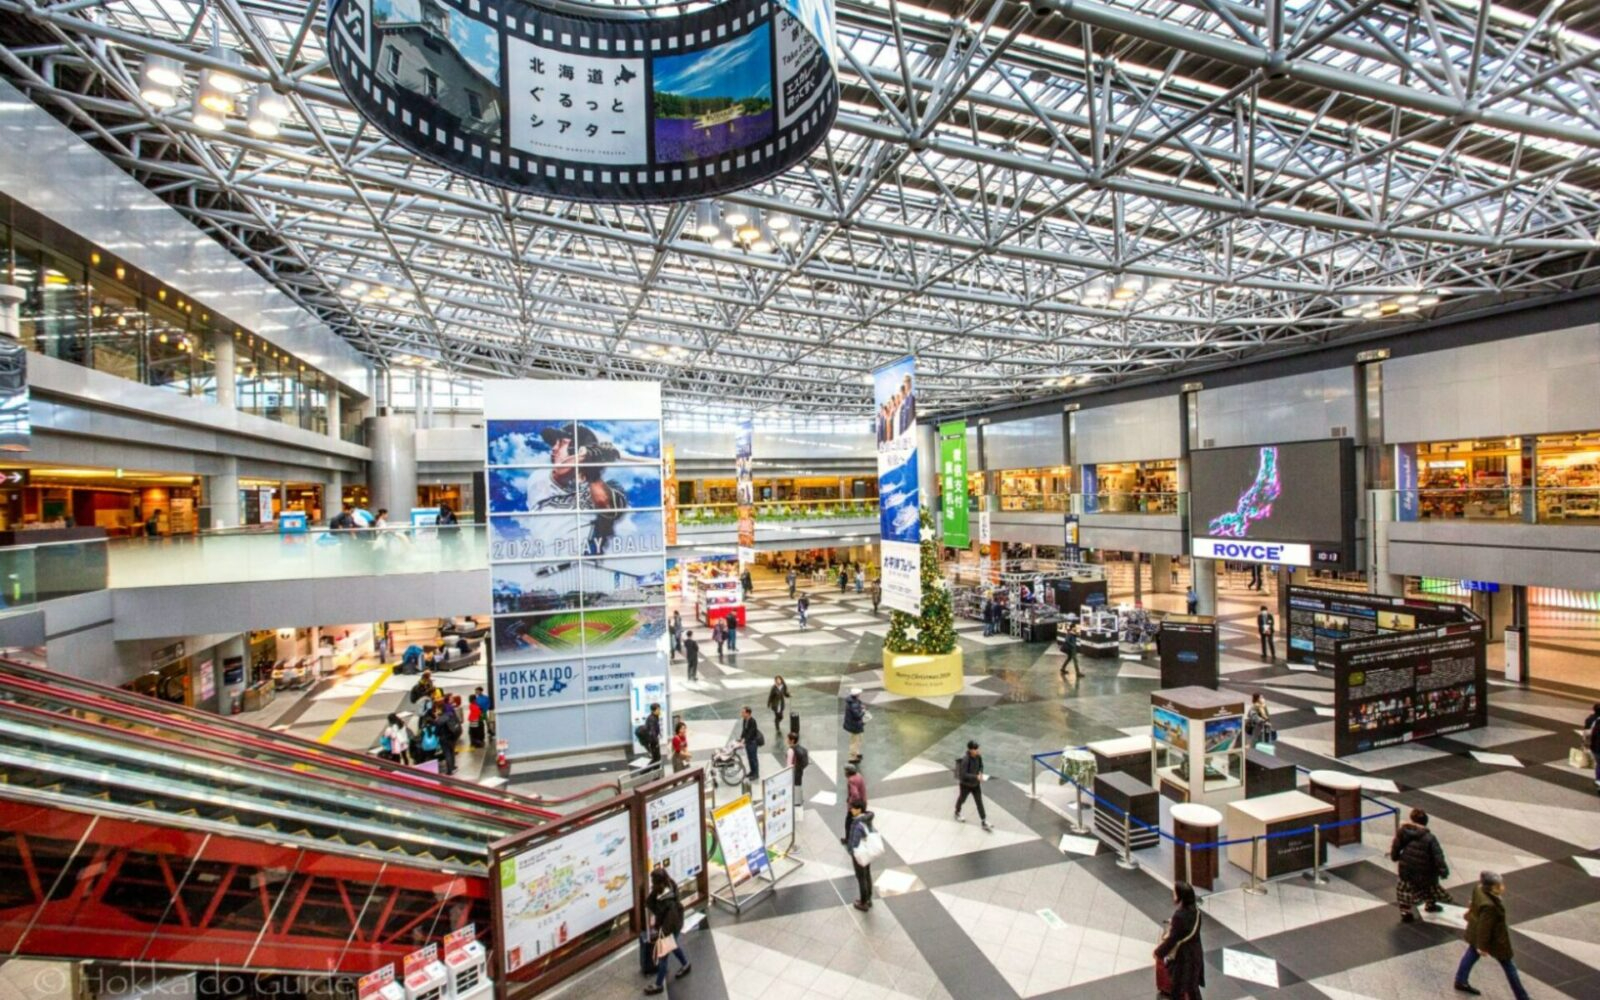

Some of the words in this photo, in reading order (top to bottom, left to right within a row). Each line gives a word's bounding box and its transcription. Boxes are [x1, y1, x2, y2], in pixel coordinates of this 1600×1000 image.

[529, 57, 604, 85] 北海道
[530, 87, 625, 113] ぐるっと
[530, 114, 626, 137] シアター
[492, 540, 546, 560] 2023
[553, 536, 603, 556] PLAY
[611, 535, 660, 553] BALL
[1213, 543, 1284, 560] ROYCE'
[498, 666, 573, 686] HOKKAIDO
[500, 684, 546, 701] PRIDE
